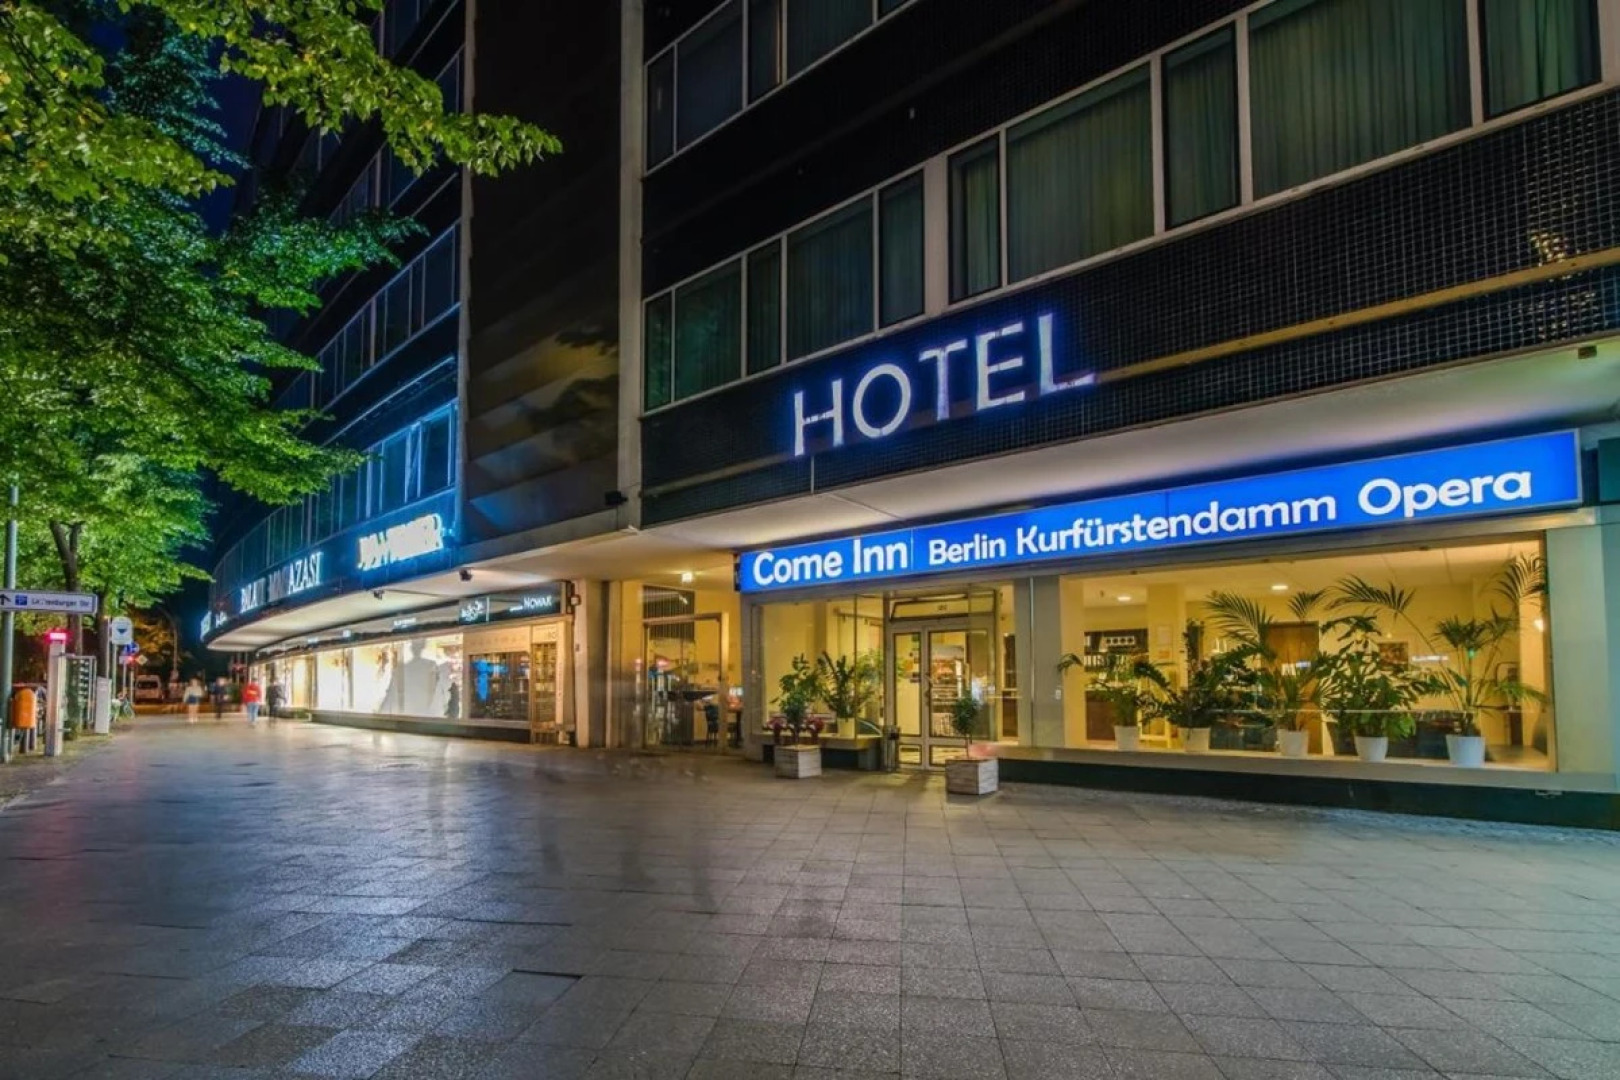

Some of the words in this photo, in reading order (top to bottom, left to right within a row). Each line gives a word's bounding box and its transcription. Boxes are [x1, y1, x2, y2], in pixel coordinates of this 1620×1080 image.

[794, 313, 1096, 457] HOTEL
[752, 550, 843, 585] Come
[853, 539, 909, 573] Inn
[928, 534, 1007, 565] Berlin
[1016, 496, 1337, 555] Kurfürstendamm
[1358, 472, 1532, 518] Opera
